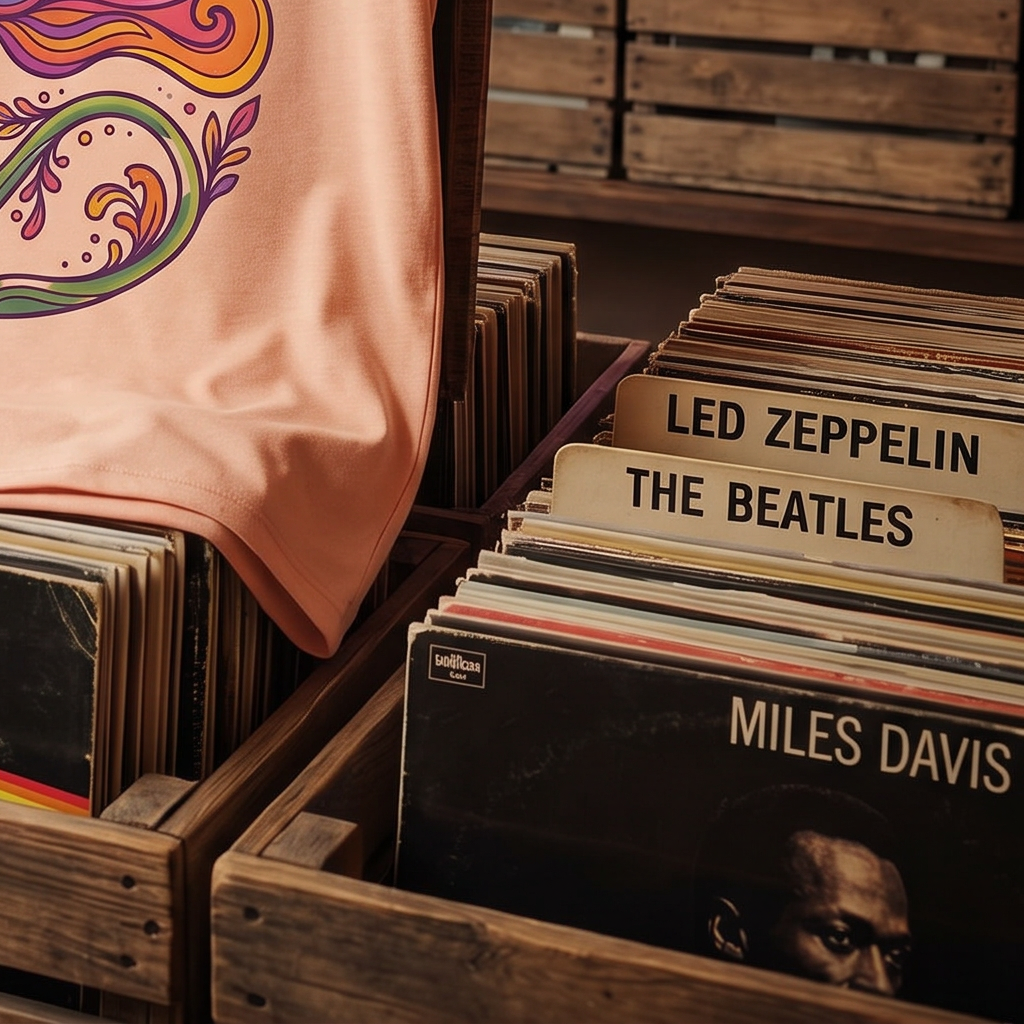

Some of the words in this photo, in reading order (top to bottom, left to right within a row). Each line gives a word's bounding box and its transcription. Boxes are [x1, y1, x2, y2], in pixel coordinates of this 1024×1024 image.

[667, 393, 746, 441] LED
[764, 406, 980, 475] ZEPPELIN
[626, 467, 705, 517] THE
[727, 481, 914, 548] BEATLES
[730, 695, 862, 766] MILES
[879, 722, 1012, 795] DAVIS
